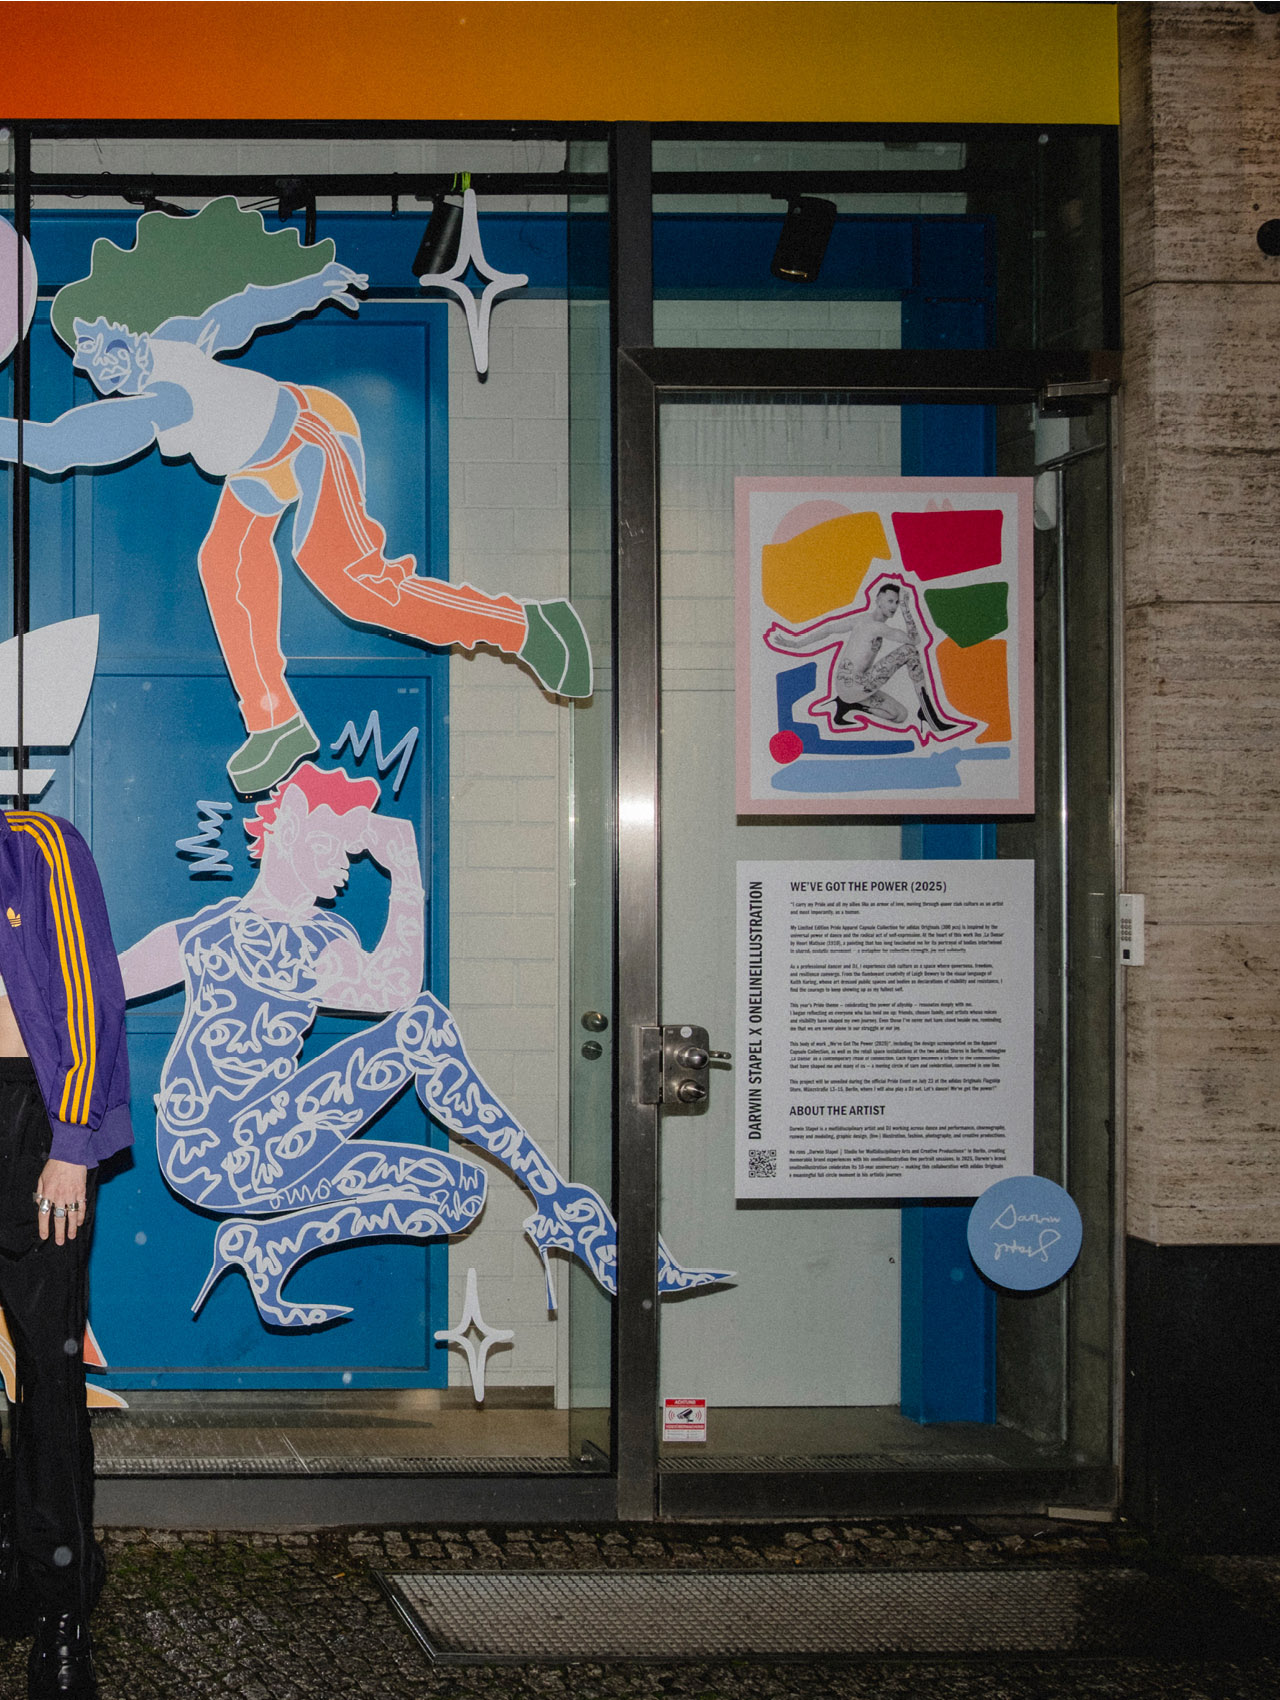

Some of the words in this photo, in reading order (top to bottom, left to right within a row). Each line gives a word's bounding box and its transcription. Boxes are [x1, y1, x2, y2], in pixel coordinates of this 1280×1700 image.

[825, 881, 846, 892] GOT
[848, 881, 868, 892] THE
[870, 881, 908, 892] POWER
[911, 881, 947, 892] (2025)
[748, 880, 762, 1024] ONELINEILLUSTRATION
[748, 1028, 762, 1036] X
[748, 1039, 762, 1084] STAPEL
[748, 1088, 762, 1140] DARWIN
[790, 1106, 825, 1116] ABOUT
[827, 1106, 847, 1116] THE
[849, 1105, 886, 1116] ARTIST
